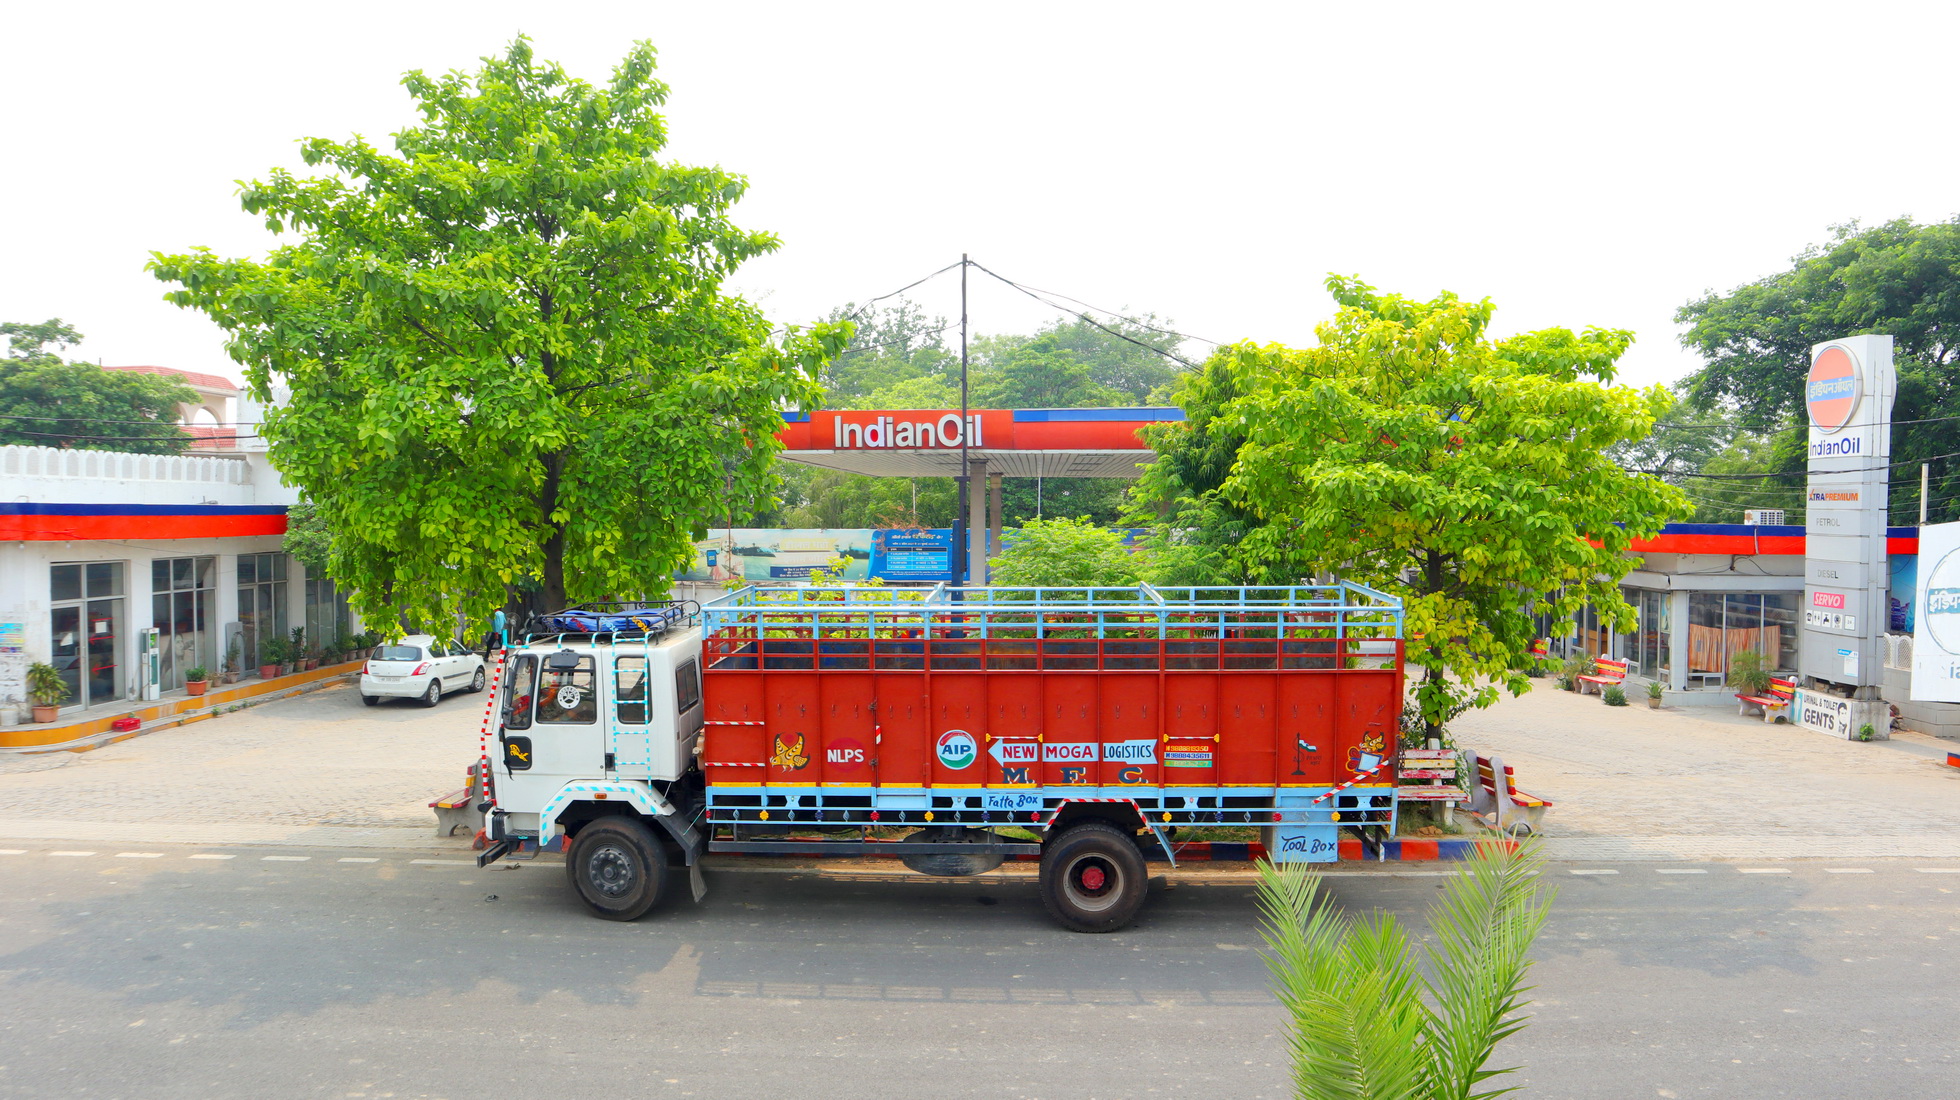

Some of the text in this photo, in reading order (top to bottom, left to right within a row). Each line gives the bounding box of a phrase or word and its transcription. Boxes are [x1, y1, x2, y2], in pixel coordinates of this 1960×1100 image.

[834, 413, 983, 449] IndianOil
[1810, 437, 1860, 456] IndianOil
[1816, 518, 1841, 527] PETROL
[1817, 568, 1839, 579] DIESEL
[1814, 593, 1841, 607] SERVO
[1803, 694, 1818, 706] URINAL
[1823, 699, 1838, 711] TOILET
[1804, 708, 1835, 730] GENTS
[827, 748, 864, 763] NLPS
[941, 744, 971, 755] AIP
[1002, 744, 1152, 759] NEW MOGA LOGISTICS
